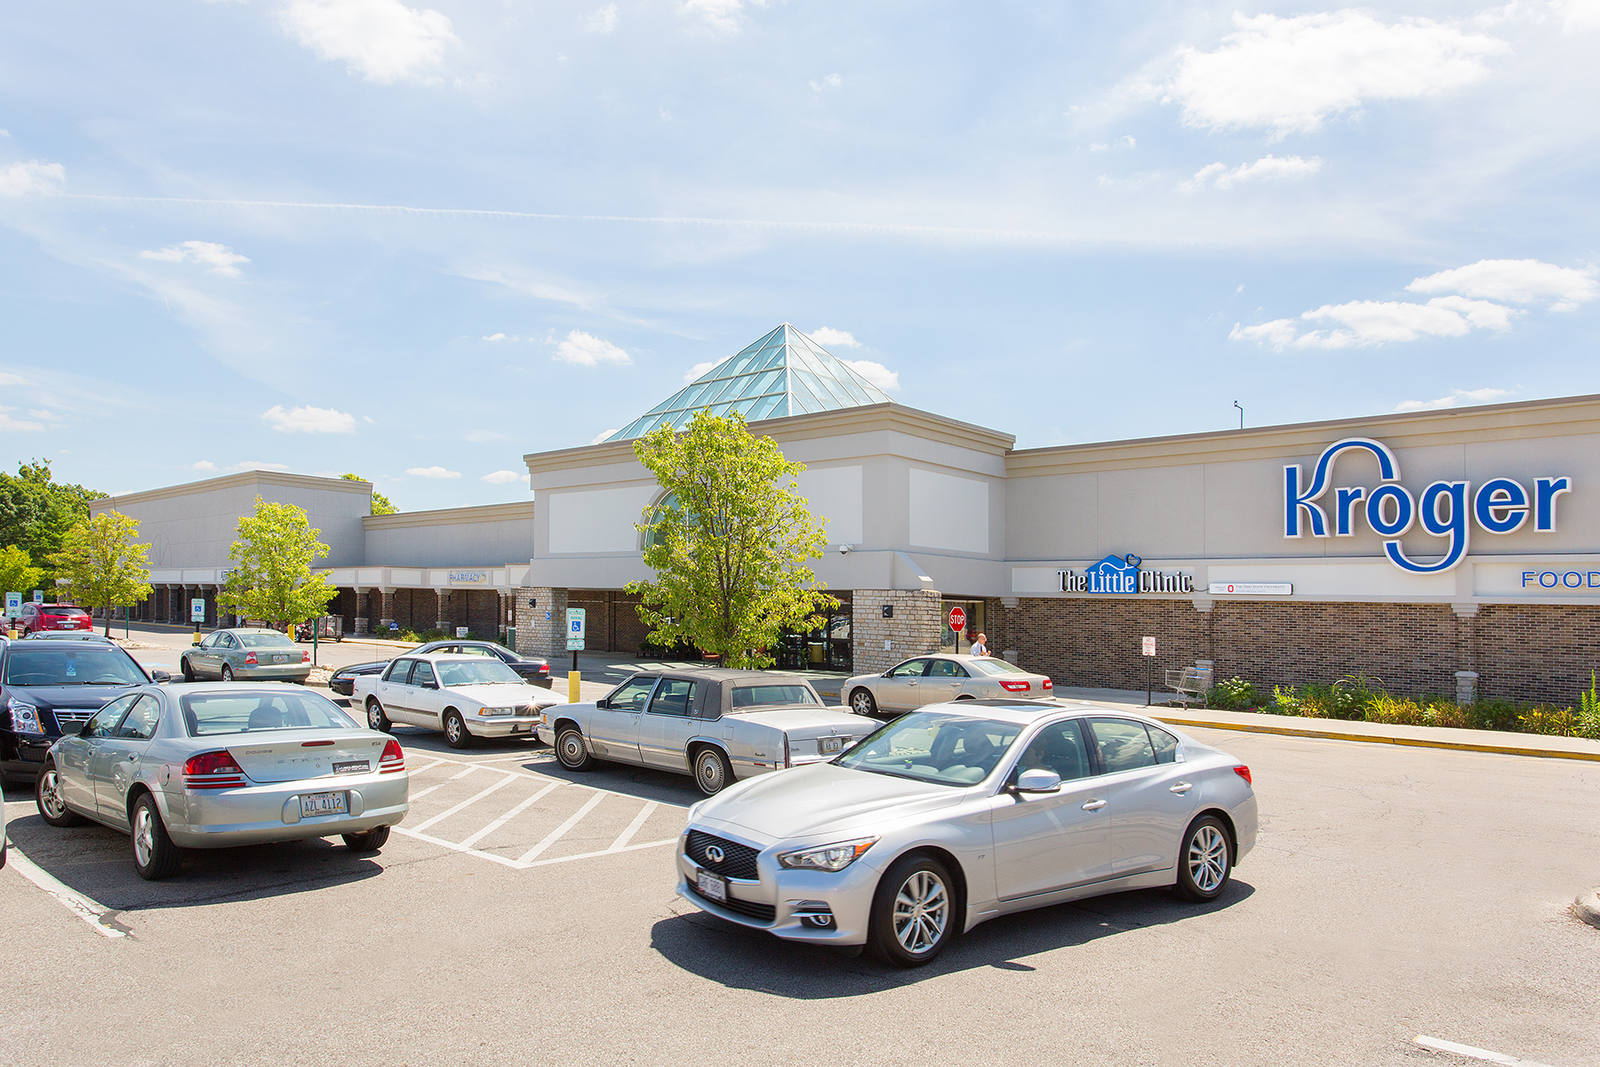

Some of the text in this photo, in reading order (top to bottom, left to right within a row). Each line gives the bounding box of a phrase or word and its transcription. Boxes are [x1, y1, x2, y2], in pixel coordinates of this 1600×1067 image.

[1283, 437, 1572, 574] Kroger
[449, 573, 481, 583] PHARMACY
[1057, 570, 1194, 593] The Little Clinic
[950, 614, 965, 625] STOP
[304, 797, 343, 812] AZL 4112
